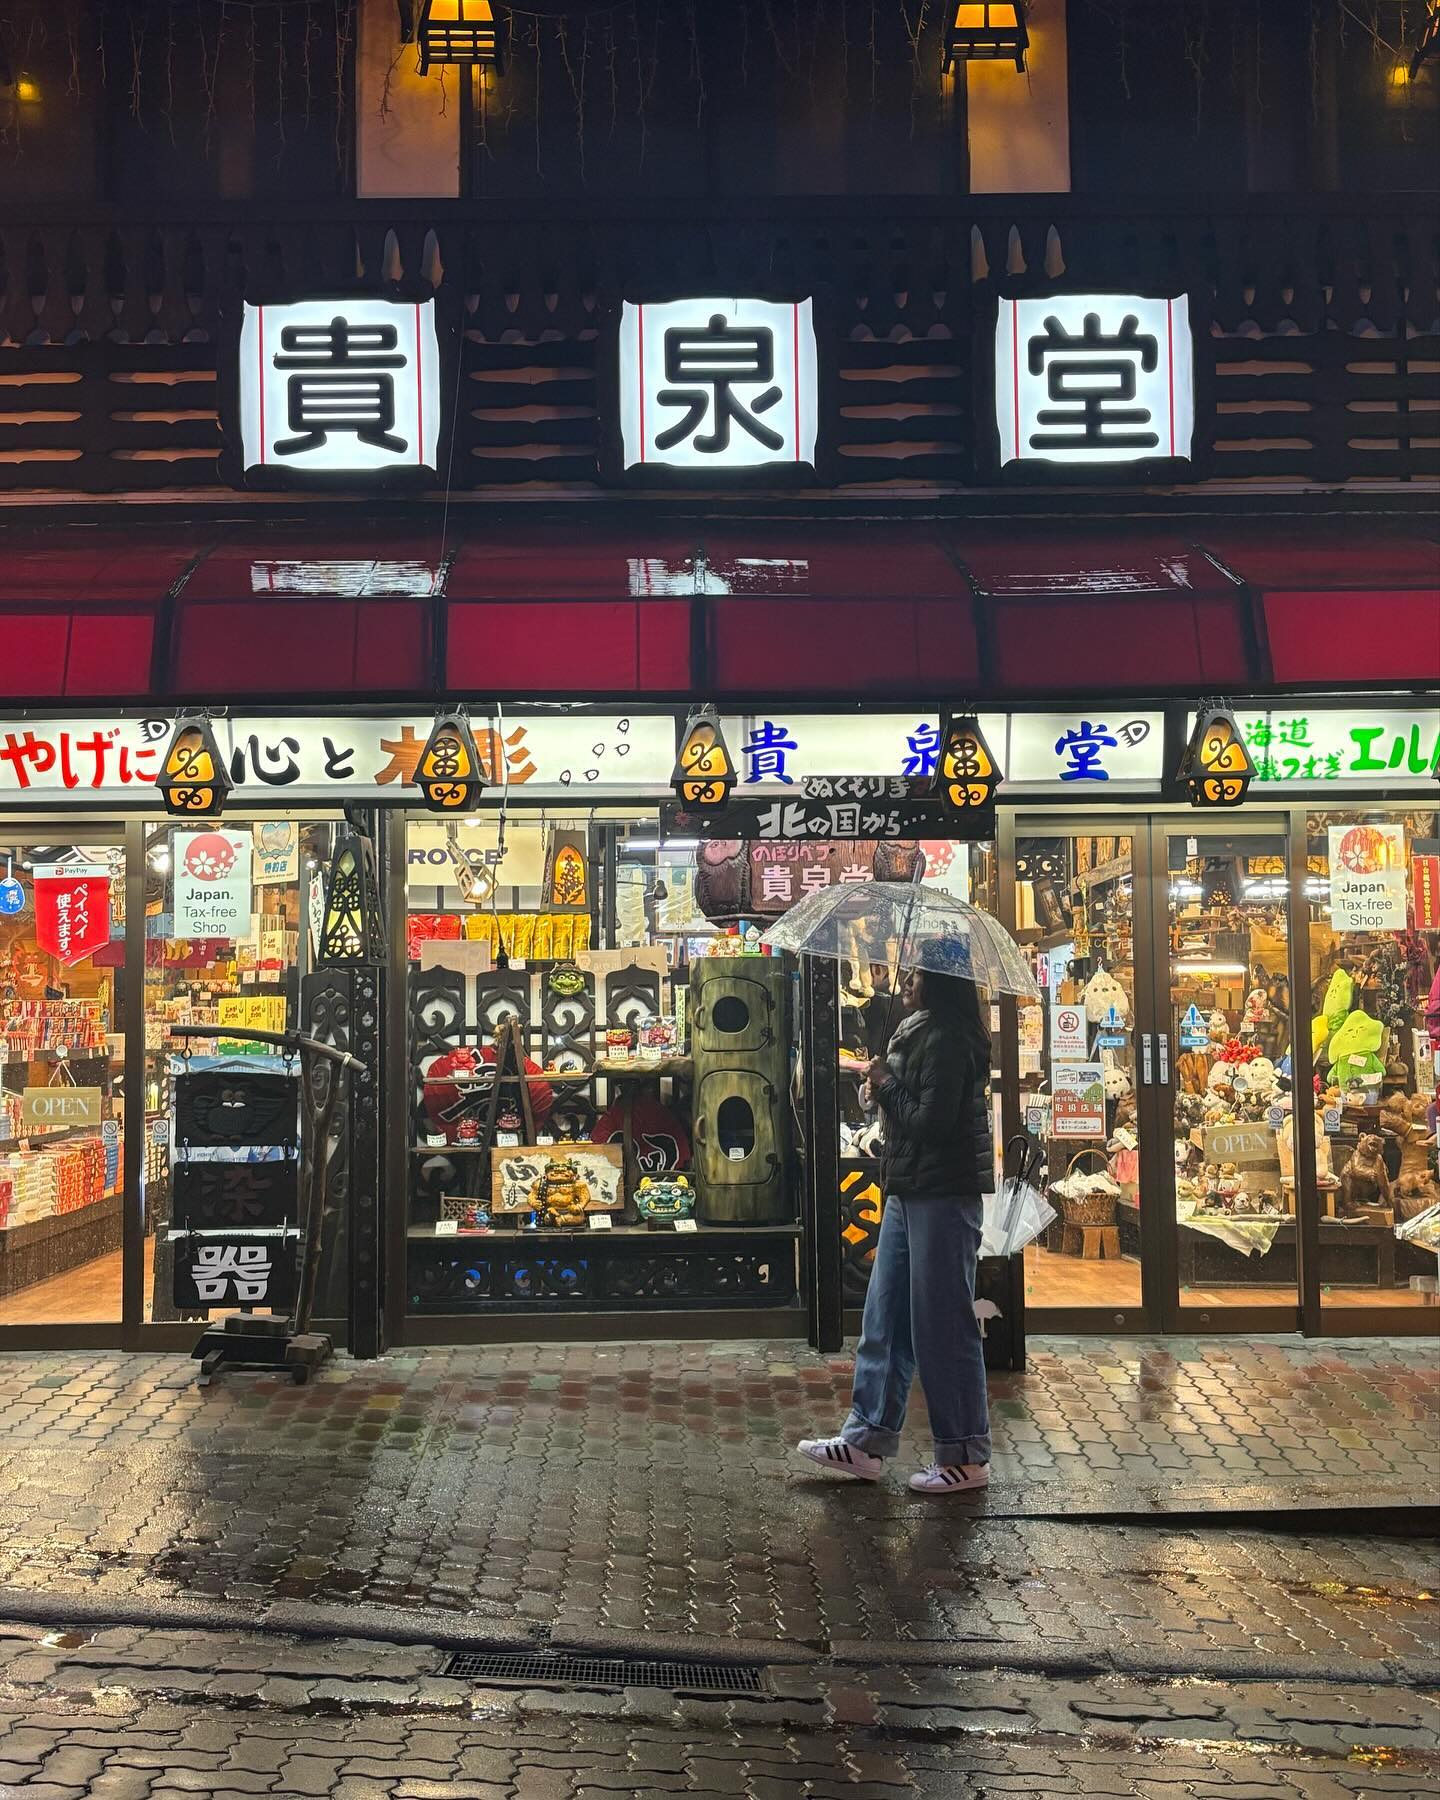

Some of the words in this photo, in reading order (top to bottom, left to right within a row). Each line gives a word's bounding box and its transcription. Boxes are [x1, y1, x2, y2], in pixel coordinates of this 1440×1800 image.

[186, 888, 235, 902] Japan.
[73, 883, 89, 939] ペイペイ
[183, 905, 237, 919] Tax-free
[1339, 898, 1393, 911] Tax-free
[192, 921, 228, 936] Shop
[1350, 914, 1384, 928] Shop
[32, 1097, 91, 1117] OPEN
[1212, 1133, 1269, 1154] OPEN
[191, 1245, 273, 1301] 器
